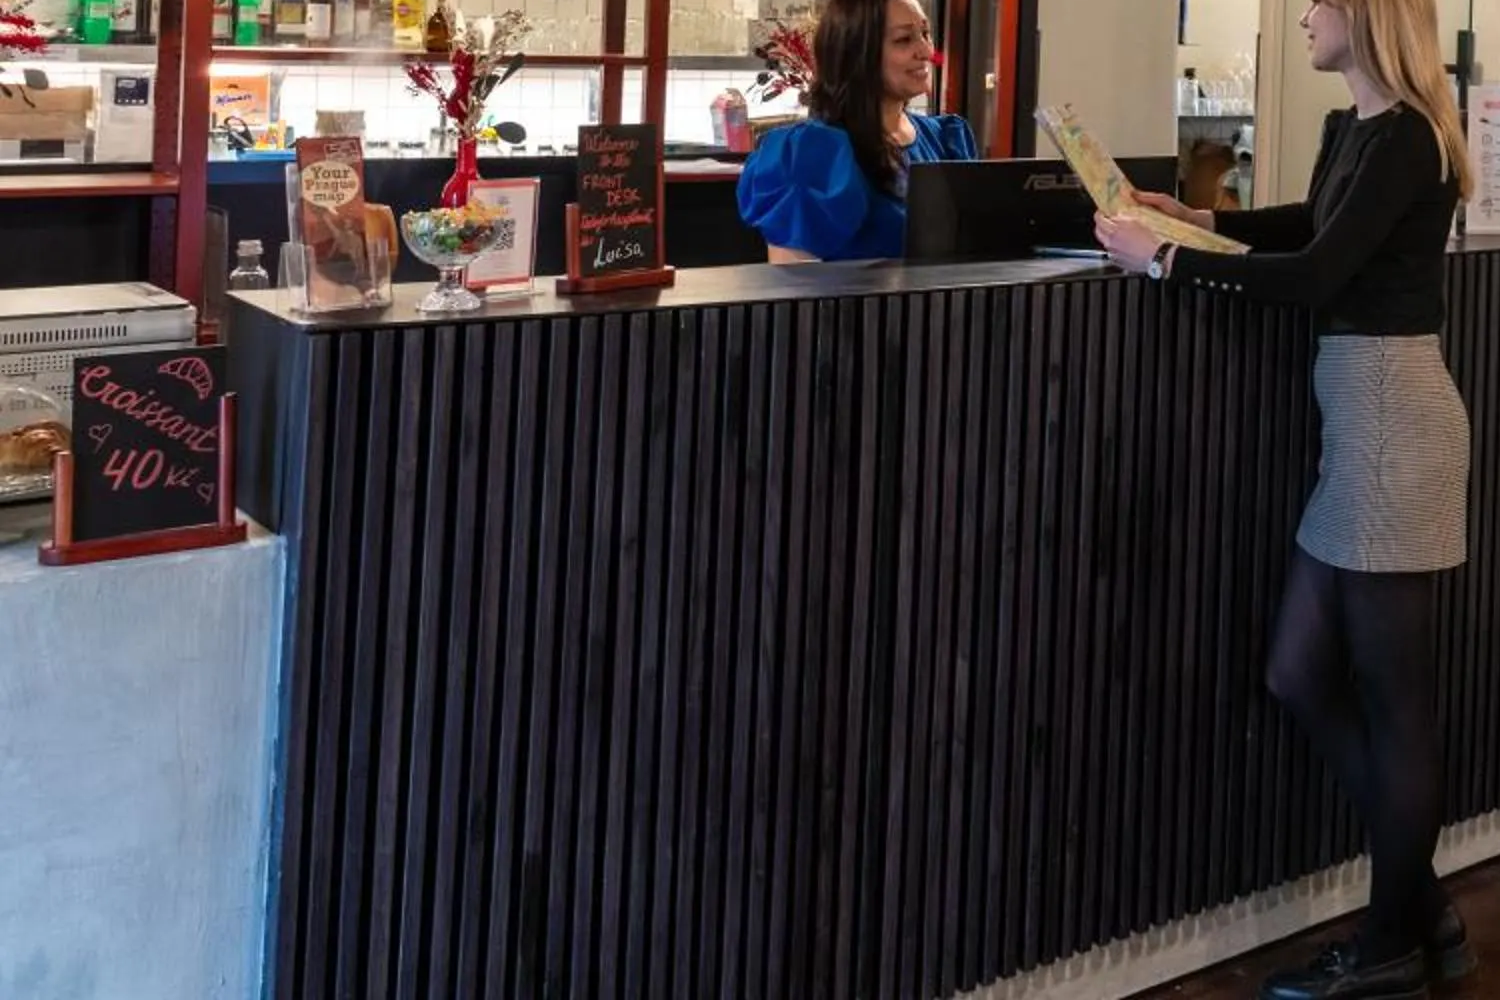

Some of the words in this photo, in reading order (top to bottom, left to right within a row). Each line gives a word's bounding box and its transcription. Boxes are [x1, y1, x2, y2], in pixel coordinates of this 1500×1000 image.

[310, 167, 352, 180] Your
[304, 179, 357, 192] Prague
[313, 192, 345, 204] map
[79, 365, 219, 452] Croissant
[103, 448, 165, 491] 40
